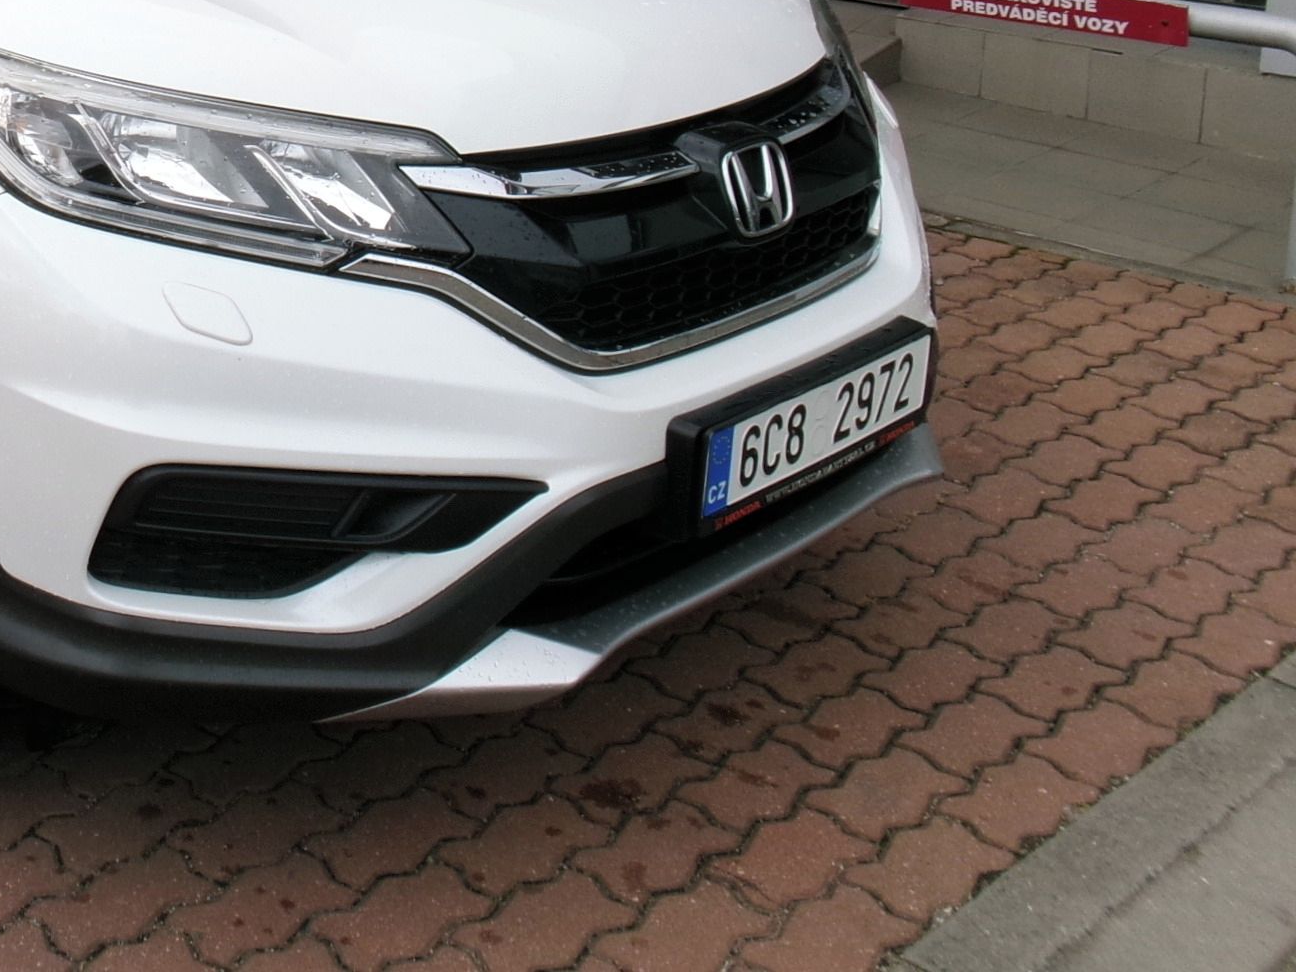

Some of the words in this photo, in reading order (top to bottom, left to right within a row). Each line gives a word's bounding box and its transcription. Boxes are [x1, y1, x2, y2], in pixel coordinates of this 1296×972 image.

[1073, 15, 1129, 35] VOZY
[739, 404, 807, 487] 6C8
[832, 353, 914, 444] 2972
[708, 480, 727, 504] CZ
